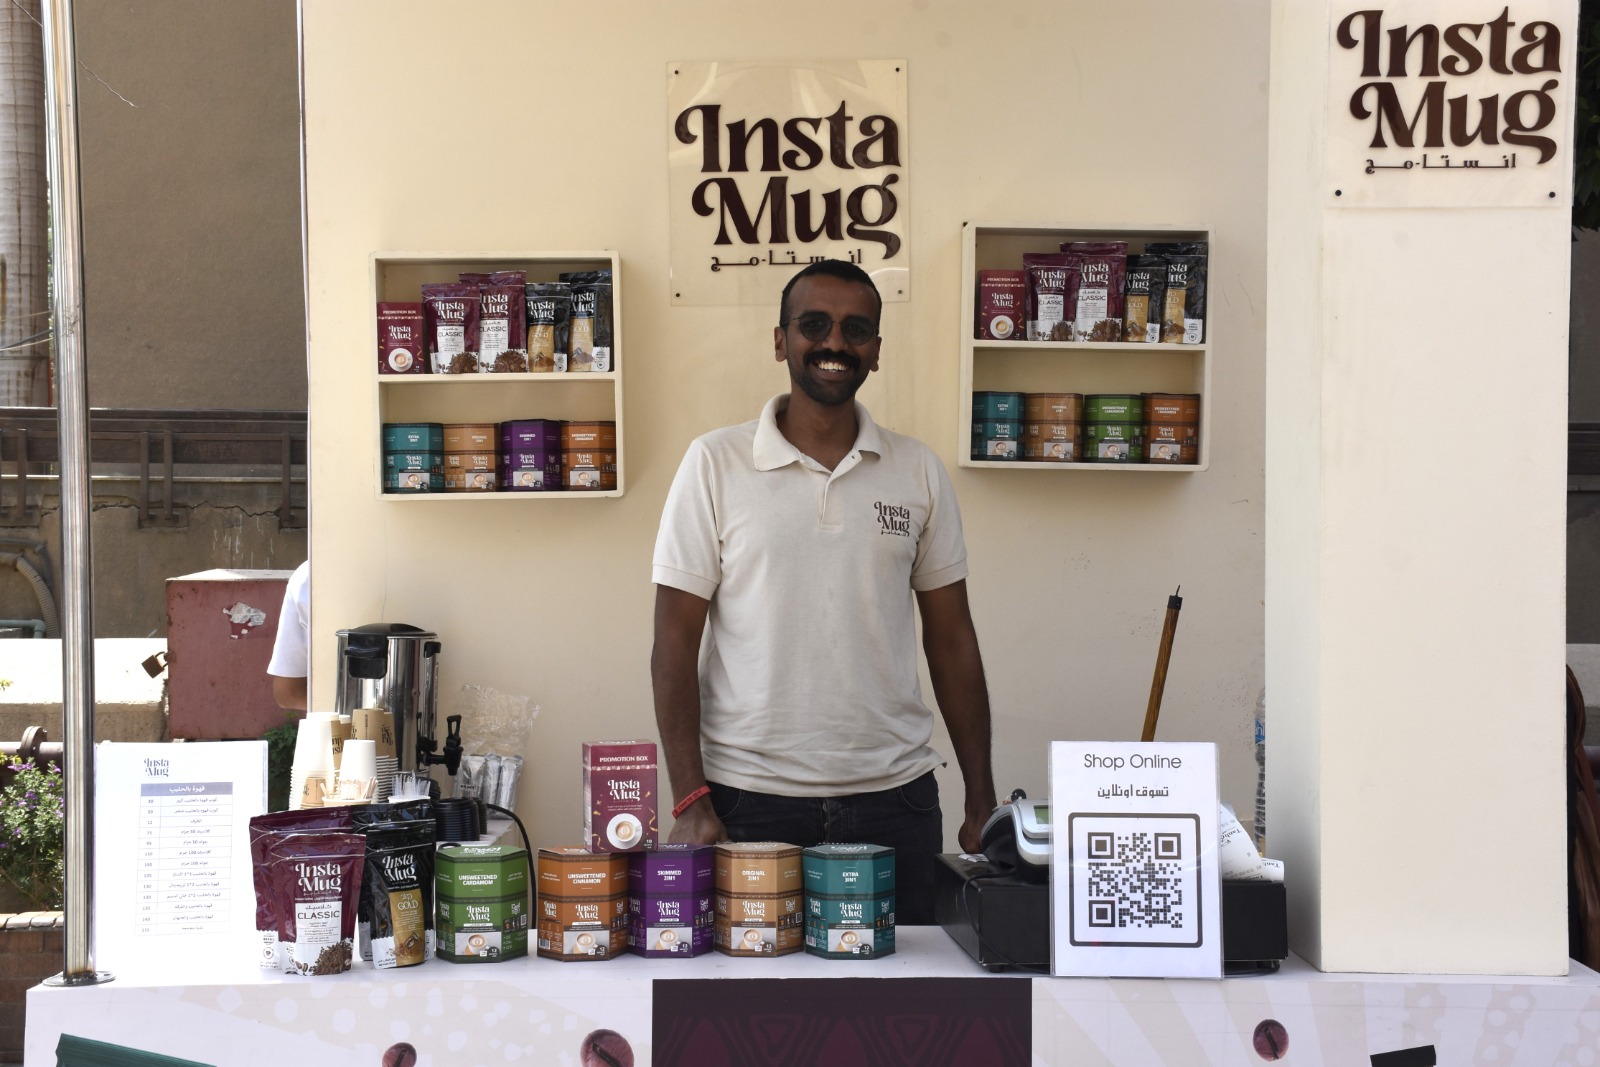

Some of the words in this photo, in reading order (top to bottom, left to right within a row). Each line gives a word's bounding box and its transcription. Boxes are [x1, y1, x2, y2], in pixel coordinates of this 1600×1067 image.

[1336, 6, 1562, 77] Insta
[1350, 79, 1559, 164] Mug
[674, 100, 902, 172] Insta
[692, 174, 900, 260] Mug
[1080, 263, 1108, 272] Insta
[1038, 270, 1065, 279] Insta
[1081, 272, 1108, 284] Mug
[1040, 279, 1065, 289] Mug
[480, 293, 508, 303] Insta
[436, 301, 464, 310] Insta
[481, 302, 508, 315] Mug
[527, 301, 554, 310] Insta
[993, 299, 1013, 308] Mug
[438, 310, 464, 320] Mug
[530, 309, 554, 320] Mug
[390, 331, 411, 340] Mug
[874, 501, 910, 519] Insta
[877, 515, 910, 537] Mug
[144, 758, 169, 767] Insta
[1084, 754, 1124, 771] Shop
[1130, 754, 1182, 769] Online
[145, 767, 169, 777] Mug
[608, 780, 640, 789] Insta
[609, 789, 640, 801] Mug
[1097, 784, 1134, 799] اونلاين
[1136, 786, 1169, 797] تسوق
[382, 853, 414, 868] Insta
[295, 862, 341, 877] Insta
[384, 865, 417, 882] Mug
[298, 876, 342, 893] Mug
[398, 900, 418, 910] GOLD
[466, 905, 490, 913] Insta
[576, 904, 598, 912] Insta
[657, 901, 680, 909] Insta
[742, 901, 765, 909] Insta
[839, 902, 862, 911] Insta
[297, 911, 340, 919] CLASSIC
[468, 912, 490, 921] Mug
[658, 908, 680, 916] Mug
[744, 908, 765, 917] Mug
[841, 910, 862, 918] Mug
